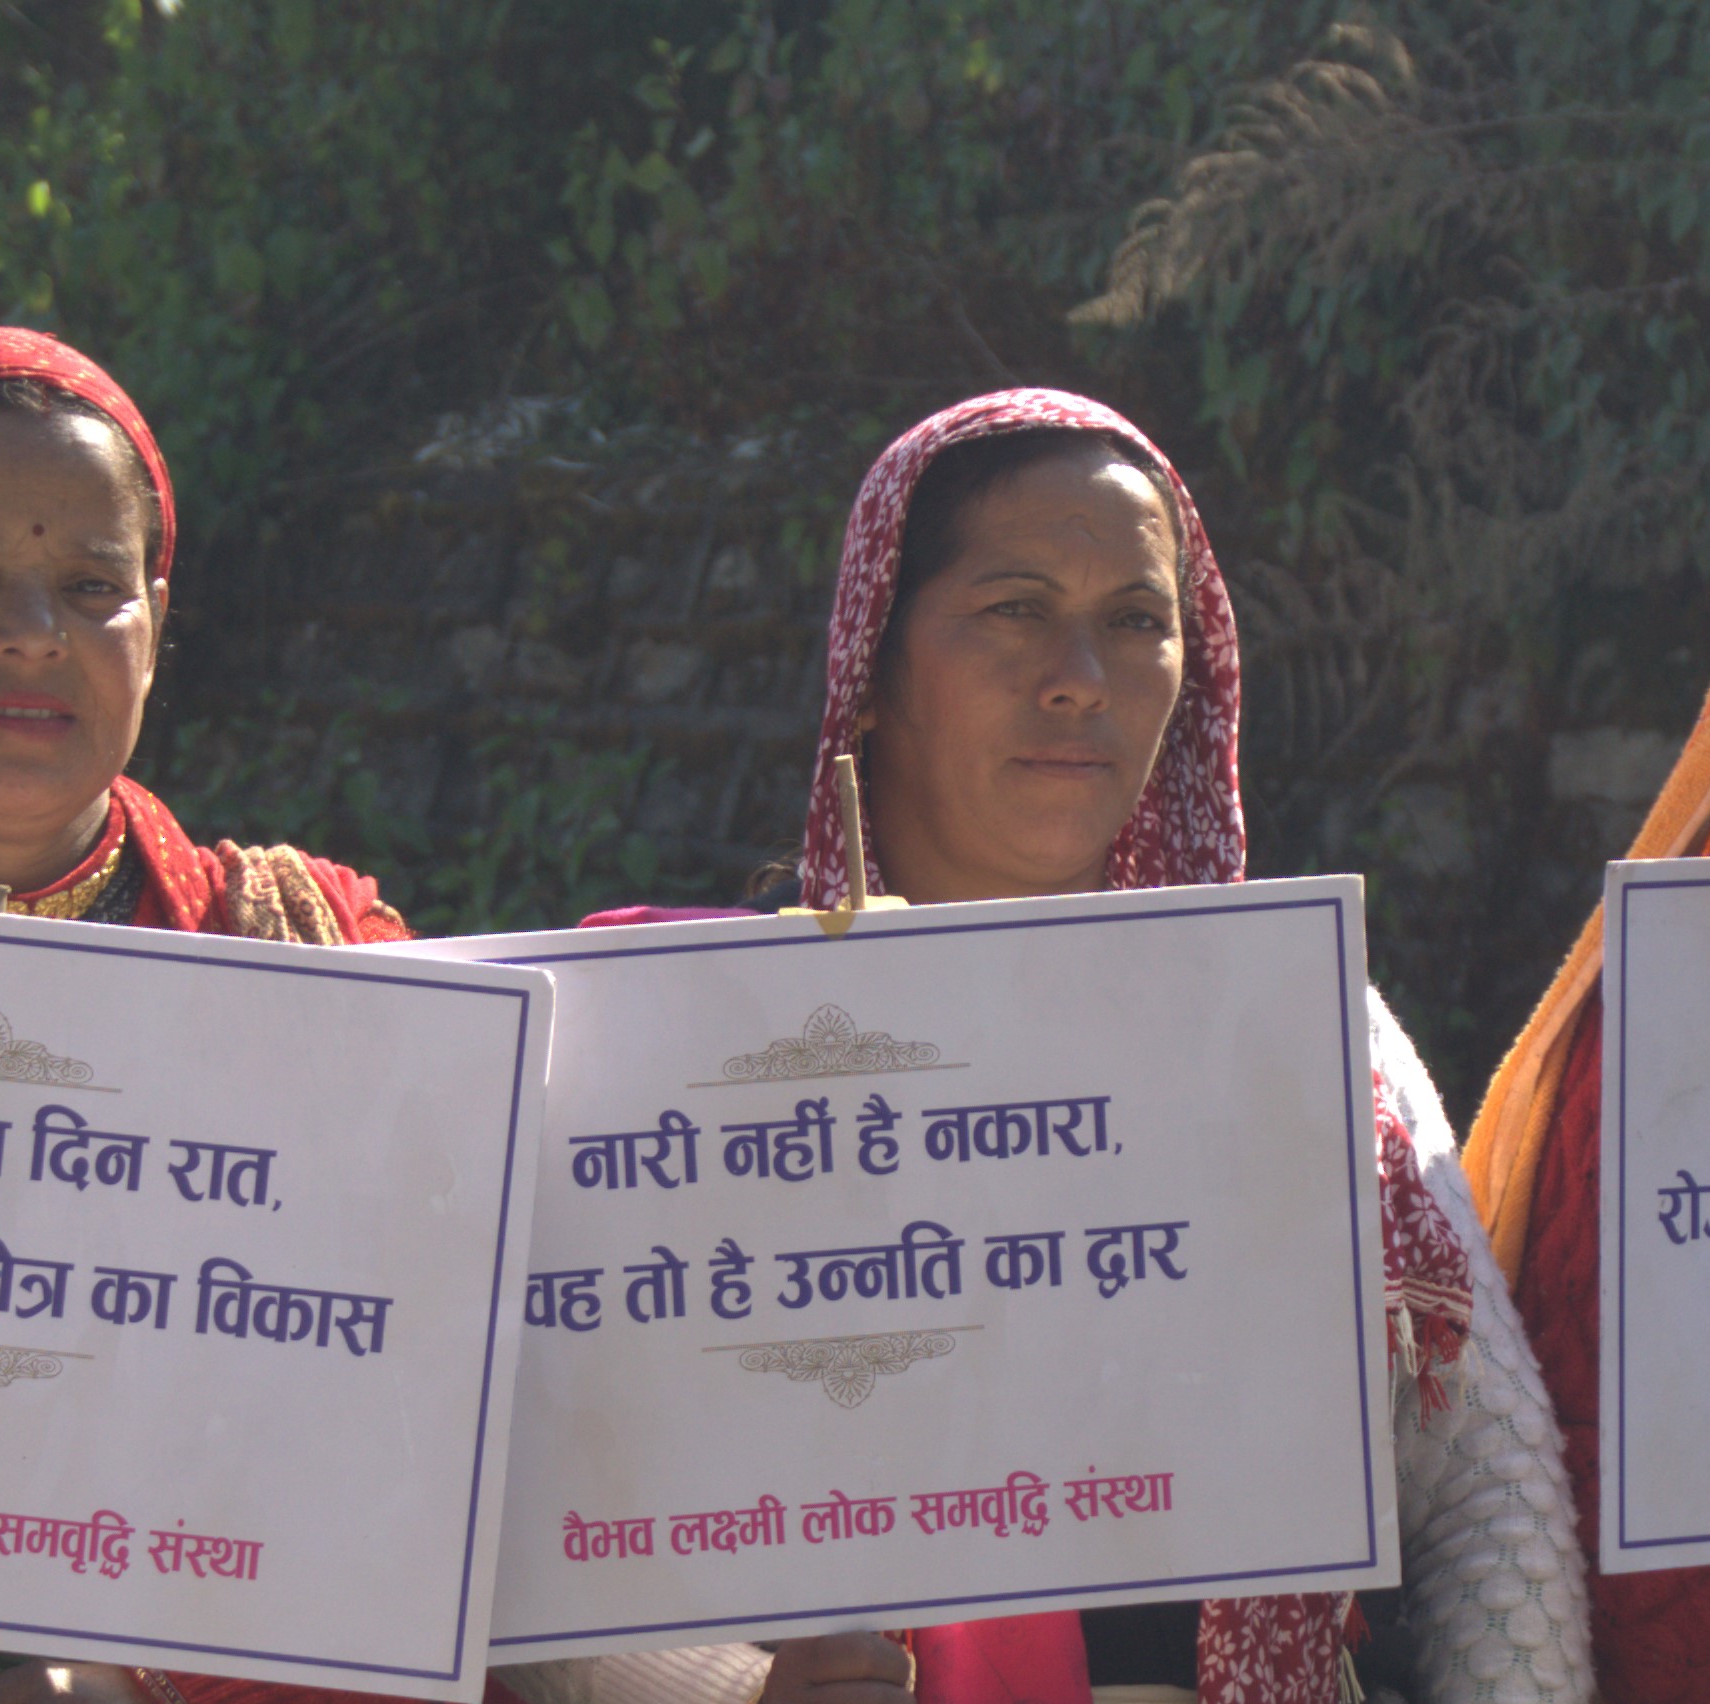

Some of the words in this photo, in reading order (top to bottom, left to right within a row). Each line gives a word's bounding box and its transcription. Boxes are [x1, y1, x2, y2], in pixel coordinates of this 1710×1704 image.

[29, 1104, 151, 1192] दिन
[167, 1139, 282, 1212] रात,
[568, 1109, 701, 1190] नारी
[720, 1096, 837, 1183] नहीं
[855, 1093, 903, 1176] है
[921, 1095, 1123, 1163] नकारा,
[90, 1266, 178, 1330] का
[195, 1256, 394, 1357] विकास
[523, 1268, 605, 1333] वह
[622, 1245, 689, 1324] तो
[708, 1237, 755, 1320] है
[774, 1220, 965, 1310] उन्नति
[984, 1230, 1066, 1290] का
[1084, 1220, 1190, 1300] द्वार
[147, 1518, 264, 1581] संस्था
[562, 1510, 656, 1562] वैभव
[668, 1493, 788, 1556] लक्ष्मी
[800, 1489, 897, 1545] लोक
[1063, 1465, 1174, 1522] संस्था
